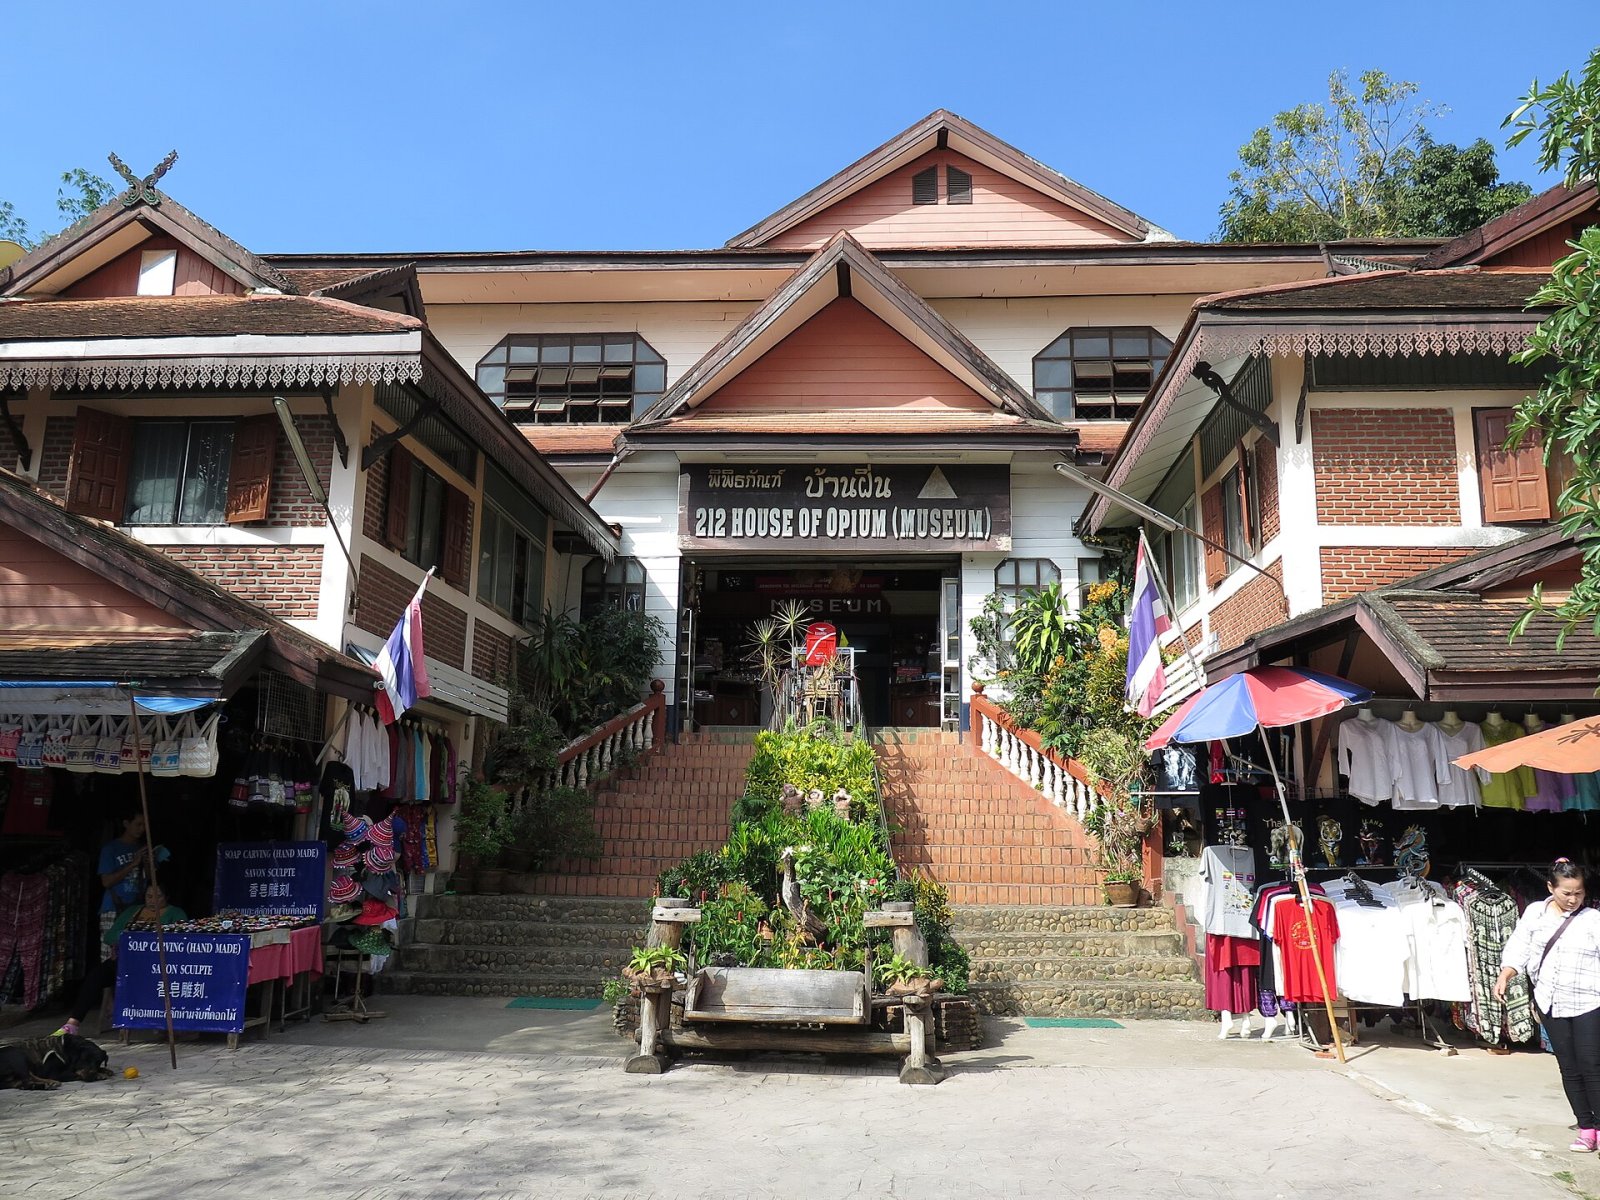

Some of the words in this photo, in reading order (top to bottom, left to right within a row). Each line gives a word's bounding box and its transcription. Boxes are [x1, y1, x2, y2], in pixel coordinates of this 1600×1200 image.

[708, 468, 786, 489] พิพิธภัณฑ์
[805, 464, 892, 499] บ้านฝิ่น
[694, 507, 727, 538] 212
[731, 507, 793, 538] HOUSE
[798, 507, 821, 538] OF
[826, 507, 887, 538] OPIUM
[893, 505, 991, 539] (MUSEUM)
[770, 598, 882, 613] MSEUM
[1262, 817, 1303, 828] Thaind
[224, 849, 242, 859] SOAP
[242, 848, 271, 859] CARVING
[272, 848, 295, 860] (HAND
[296, 847, 319, 860] MADE)
[244, 868, 266, 878] SAVON
[267, 867, 296, 878] SCULPTE
[128, 940, 149, 952] SOAP
[186, 942, 213, 955] (HAND
[214, 942, 242, 956] MADE)
[151, 963, 178, 974] SAON
[180, 964, 213, 976] SCULPTE
